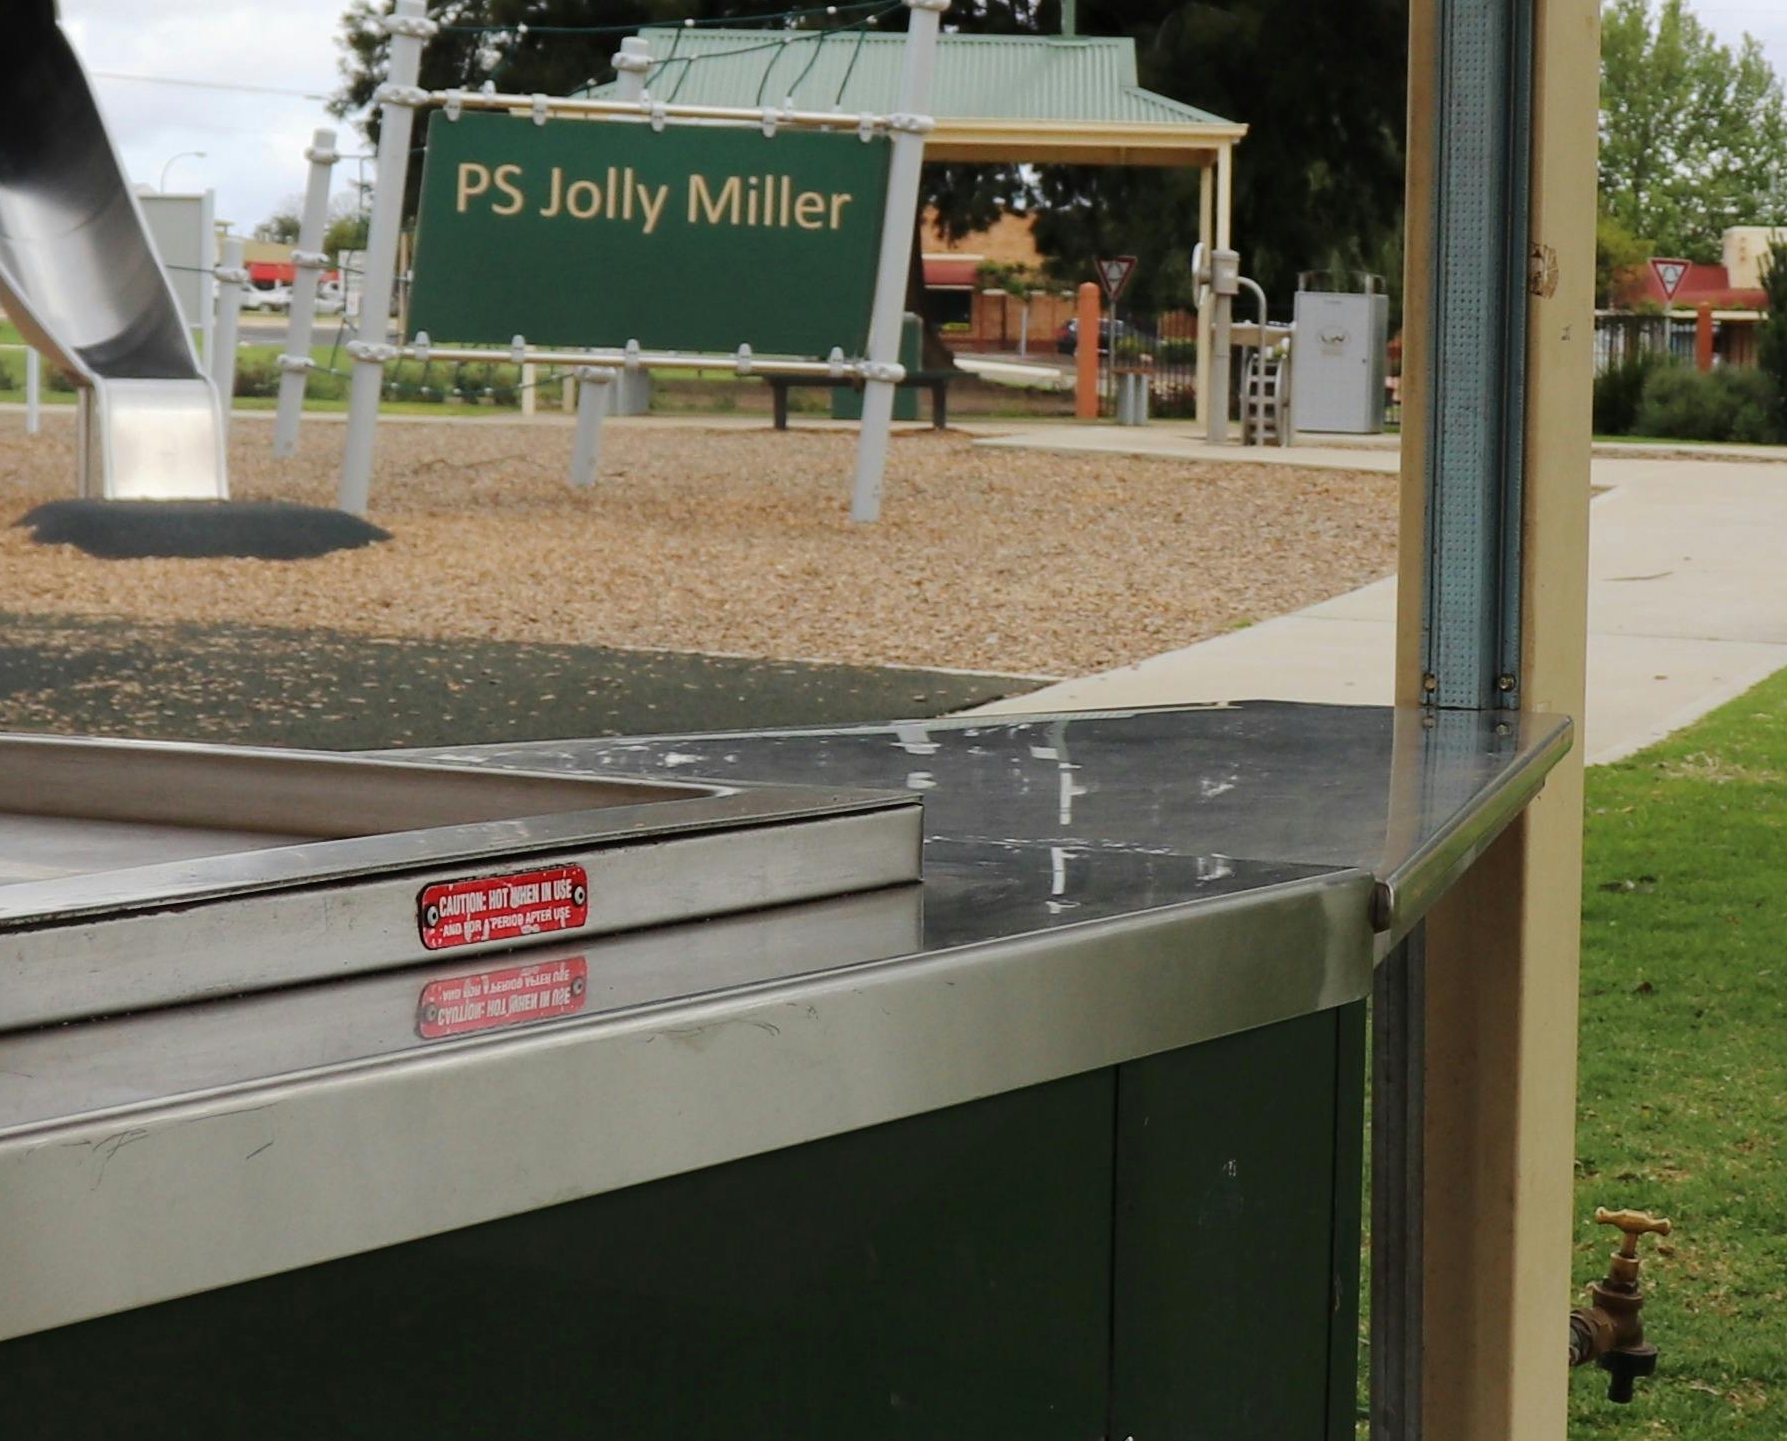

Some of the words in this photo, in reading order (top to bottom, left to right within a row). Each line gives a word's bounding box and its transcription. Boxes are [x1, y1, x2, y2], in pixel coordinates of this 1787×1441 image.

[456, 162, 524, 216] PS
[539, 166, 669, 234] Jolly
[687, 173, 852, 230] Miller
[439, 891, 487, 918] CAUTION:
[488, 887, 509, 910] HOT
[509, 882, 539, 908] WHEN
[541, 880, 552, 902] IN
[553, 878, 572, 900] USE
[443, 922, 463, 937] AND
[490, 913, 524, 930] PERIOD
[525, 908, 553, 925] AFTER
[553, 906, 571, 920] USE
